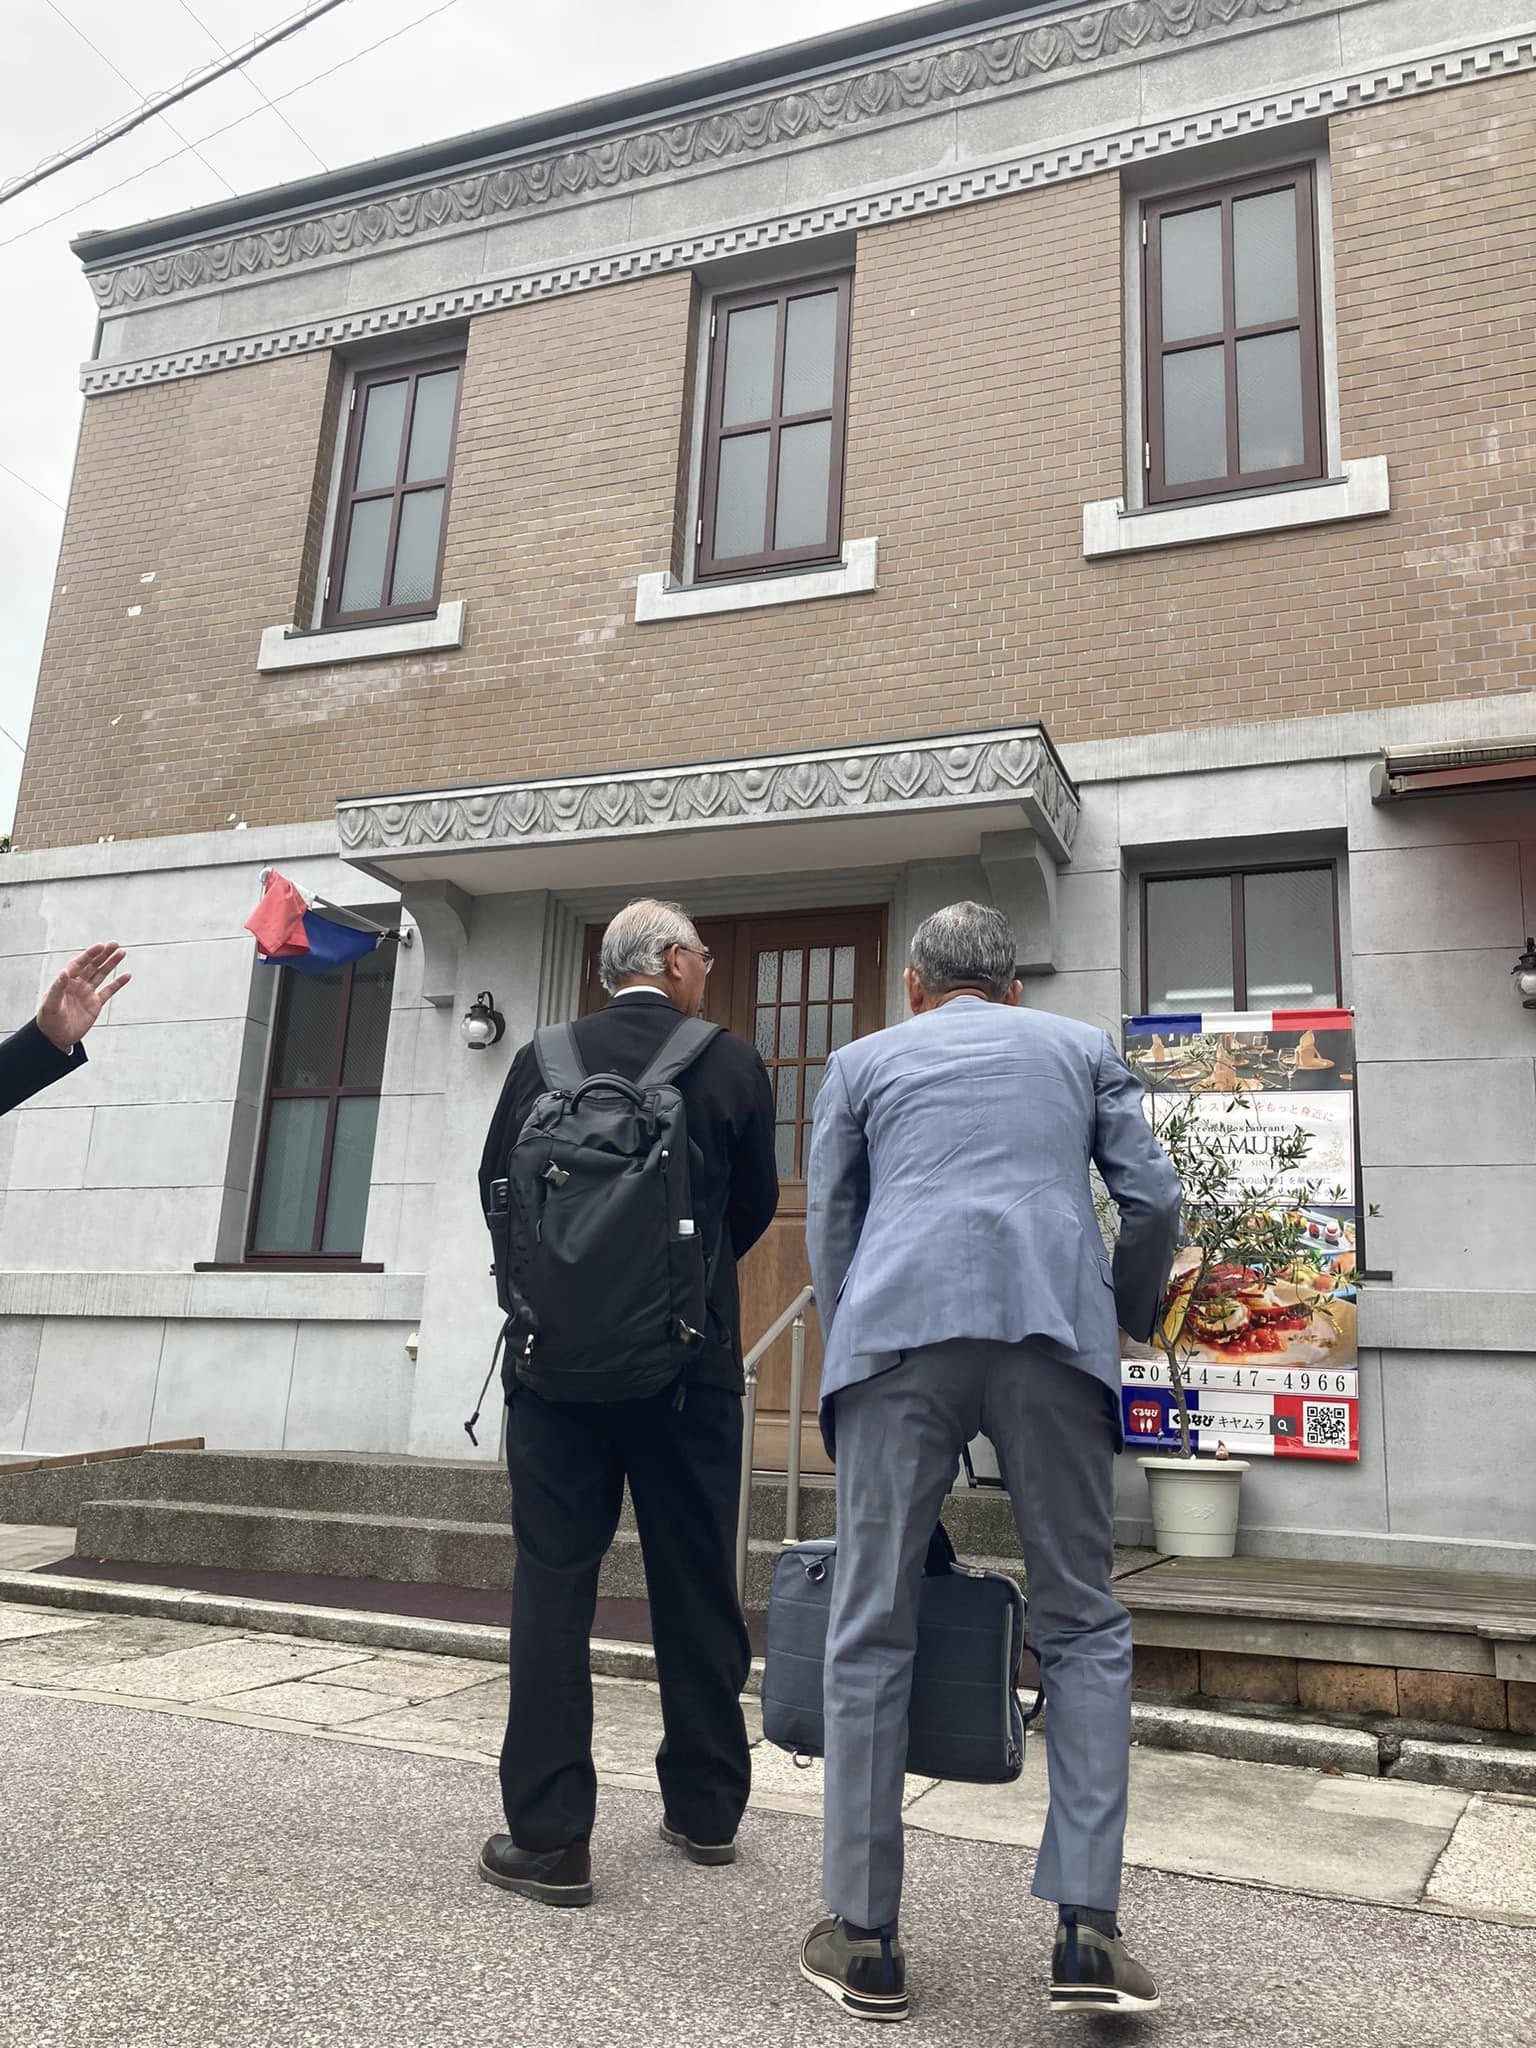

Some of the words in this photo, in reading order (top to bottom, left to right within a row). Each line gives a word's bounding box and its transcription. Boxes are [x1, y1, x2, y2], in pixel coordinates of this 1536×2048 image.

[1172, 1413, 1215, 1427] ぐなび
[1218, 1416, 1265, 1430] キヤムラ
